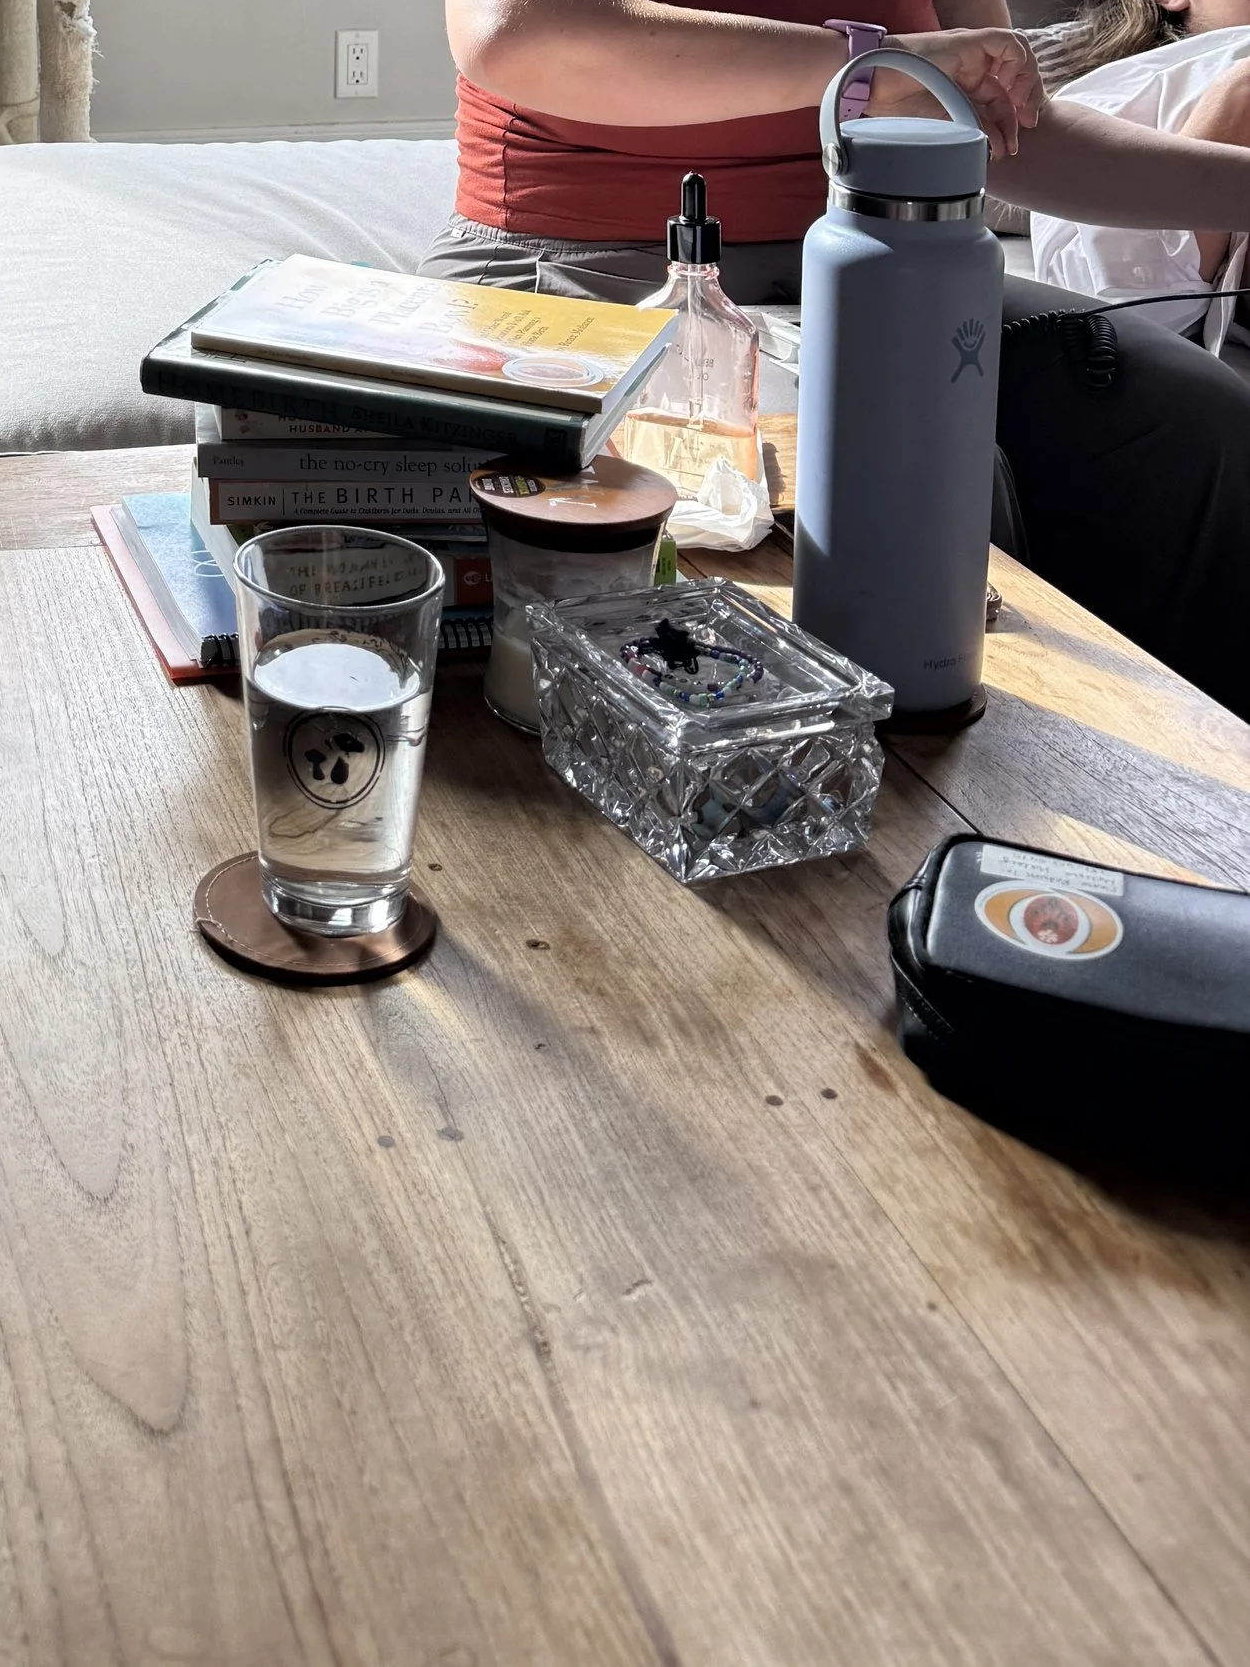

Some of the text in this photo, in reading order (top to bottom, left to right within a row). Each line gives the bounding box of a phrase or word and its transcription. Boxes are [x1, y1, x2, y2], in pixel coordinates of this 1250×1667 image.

[271, 282, 328, 311] How
[351, 405, 415, 429] SHEILA
[289, 424, 350, 433] HUSBAND
[299, 454, 327, 470] the
[332, 458, 389, 476] no-cry
[396, 455, 437, 476] sleep
[226, 495, 276, 506] SIMKIN
[291, 491, 326, 504] THE
[336, 487, 415, 504] BIRTH
[923, 658, 957, 673] Hydro
